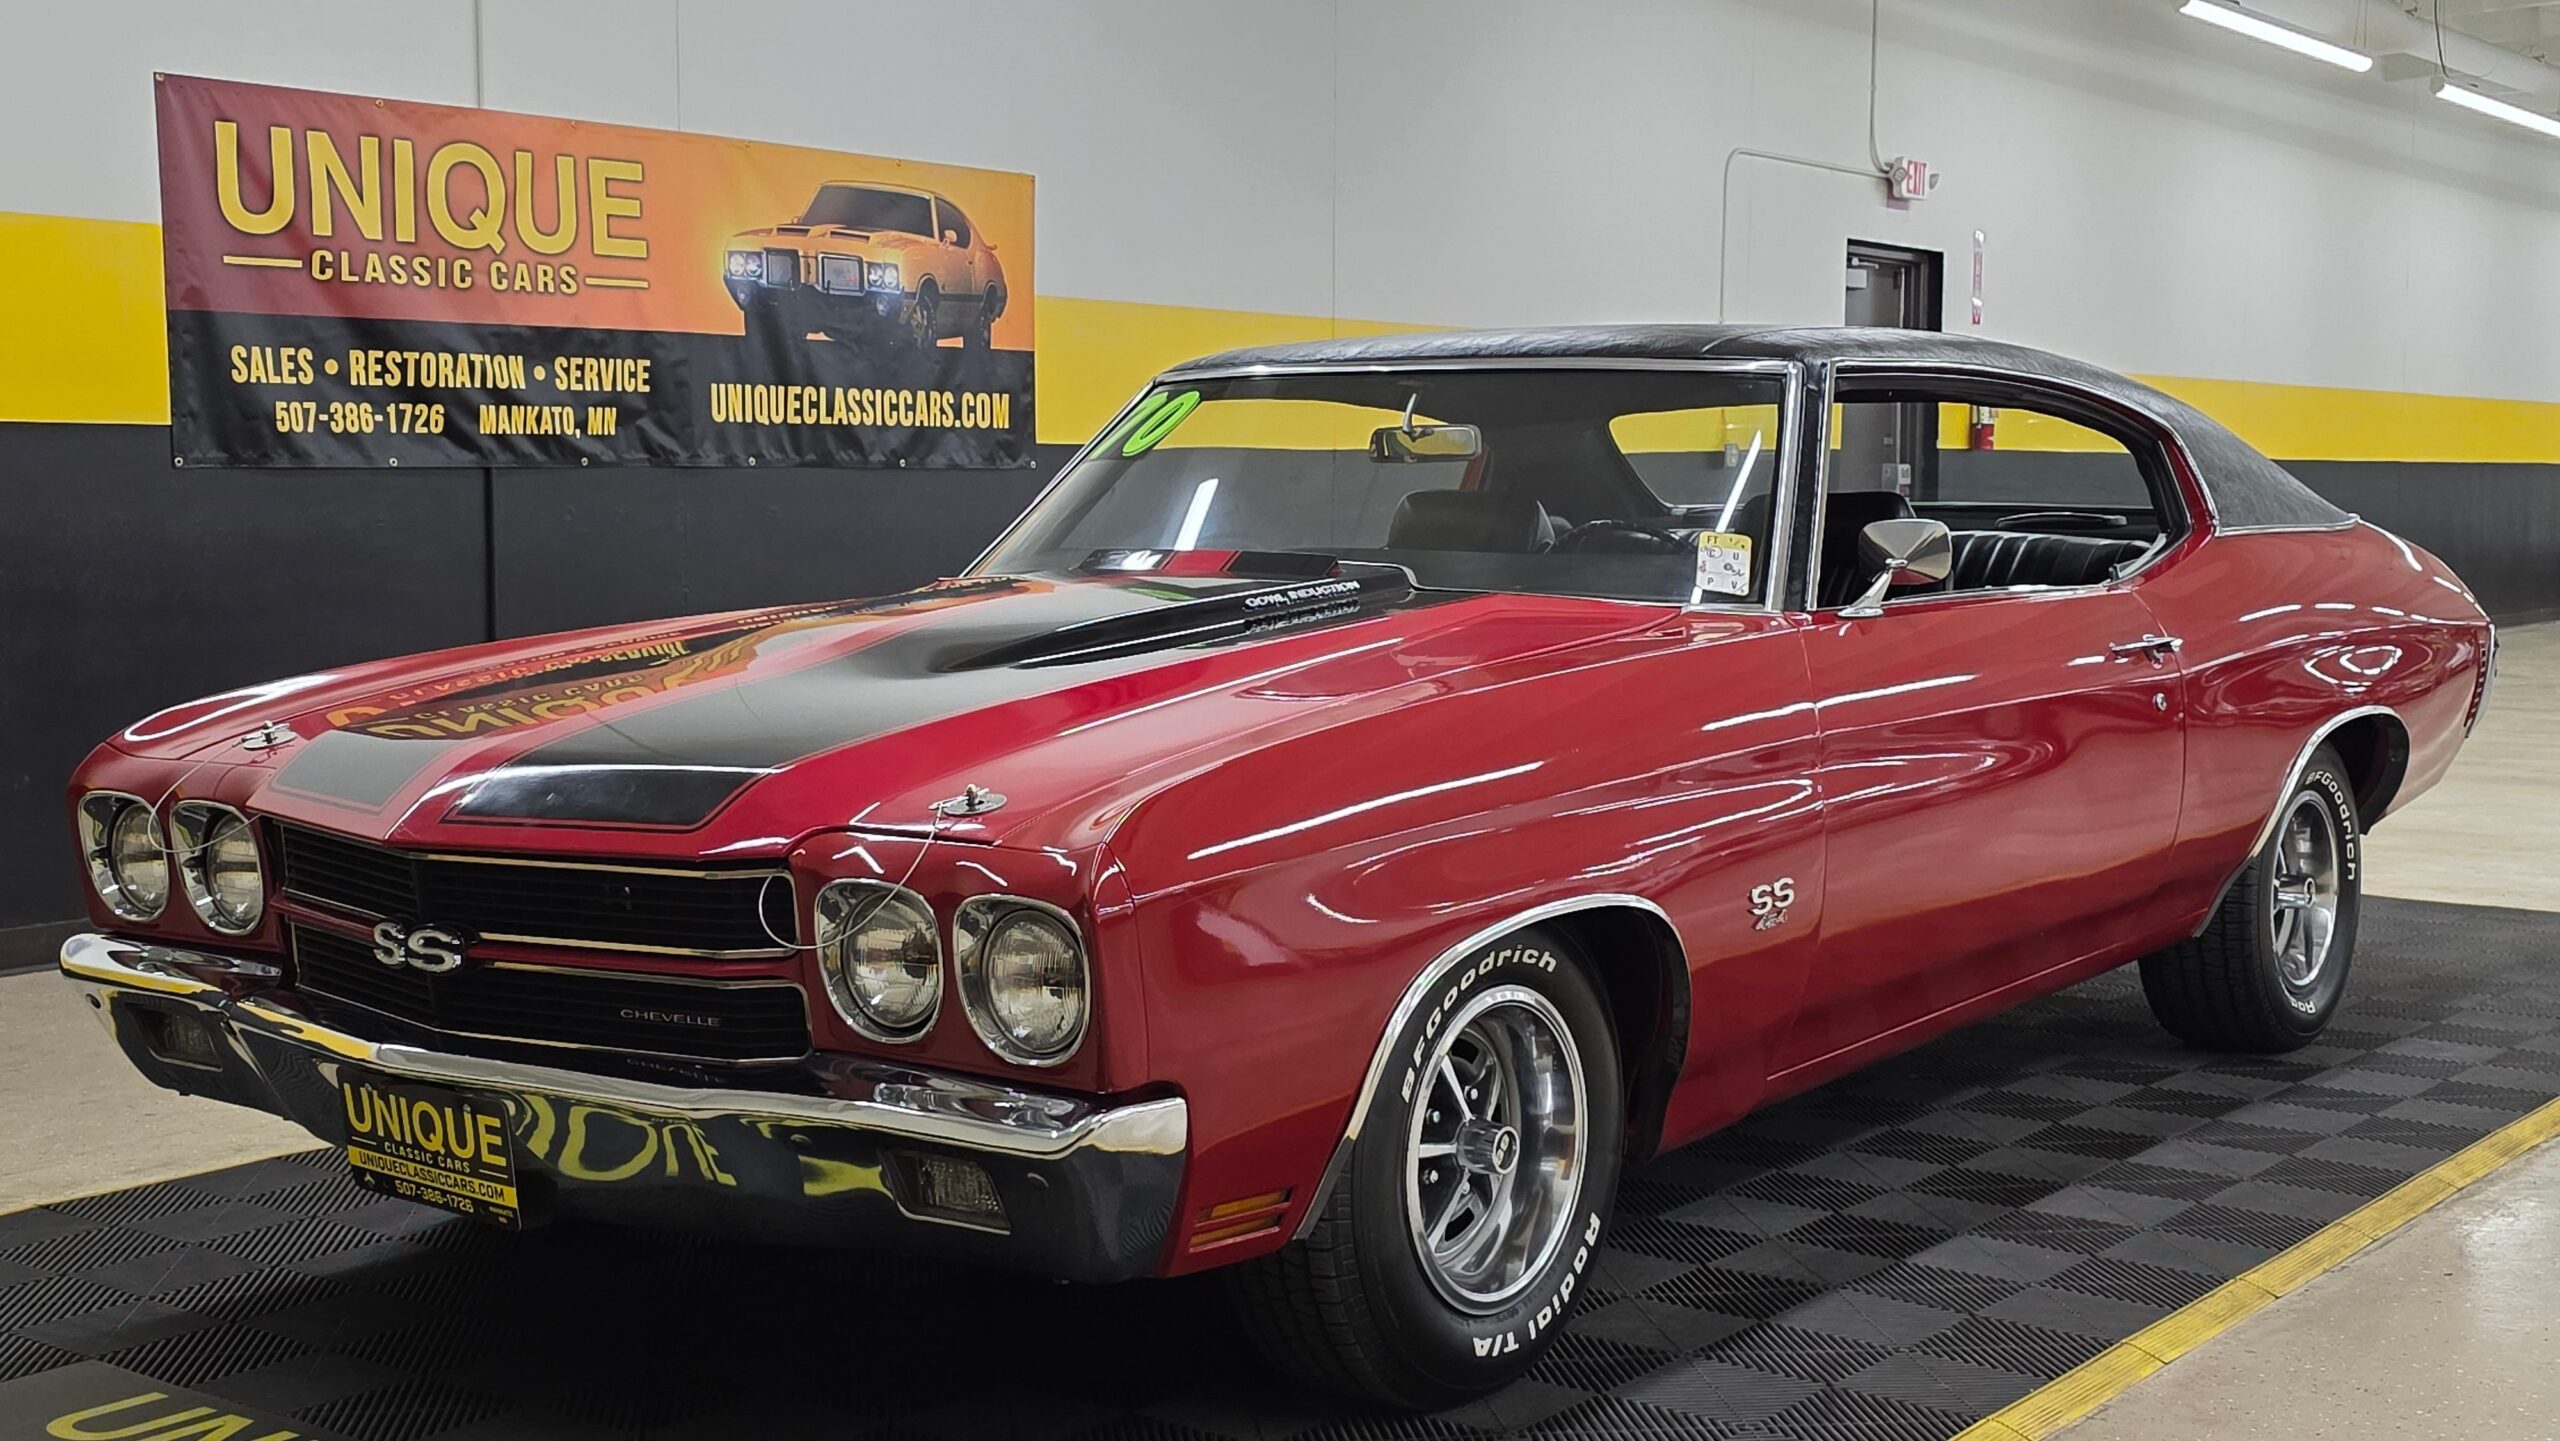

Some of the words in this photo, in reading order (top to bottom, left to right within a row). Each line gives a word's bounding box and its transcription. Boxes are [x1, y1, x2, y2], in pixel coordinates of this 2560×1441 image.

[214, 121, 648, 258] UNIQUE
[1907, 159, 1927, 196] EXIT
[311, 249, 473, 288] CLASSIC
[490, 261, 578, 294] CARS
[230, 345, 314, 385] SALES
[349, 349, 526, 390] RESTORATION
[554, 358, 651, 393] SERVICE
[275, 401, 444, 434] 507-386-1726
[479, 404, 581, 439] MANKATO,
[587, 407, 616, 436] MN
[710, 383, 1010, 429] UNIQUECLASSICCARS.COM
[1751, 877, 1795, 915] SS
[373, 921, 462, 972] SS
[620, 1008, 720, 1028] CHEVELLE
[344, 1083, 506, 1166] UNIQUE
[359, 1151, 504, 1201] UNIQUECLASSICCARS.COM
[384, 1142, 433, 1164] CLASSIC
[438, 1156, 471, 1173] CARS
[395, 1180, 474, 1213] 507-386-1726
[1472, 1331, 1519, 1357] T/A
[46, 1391, 318, 1441] UN
